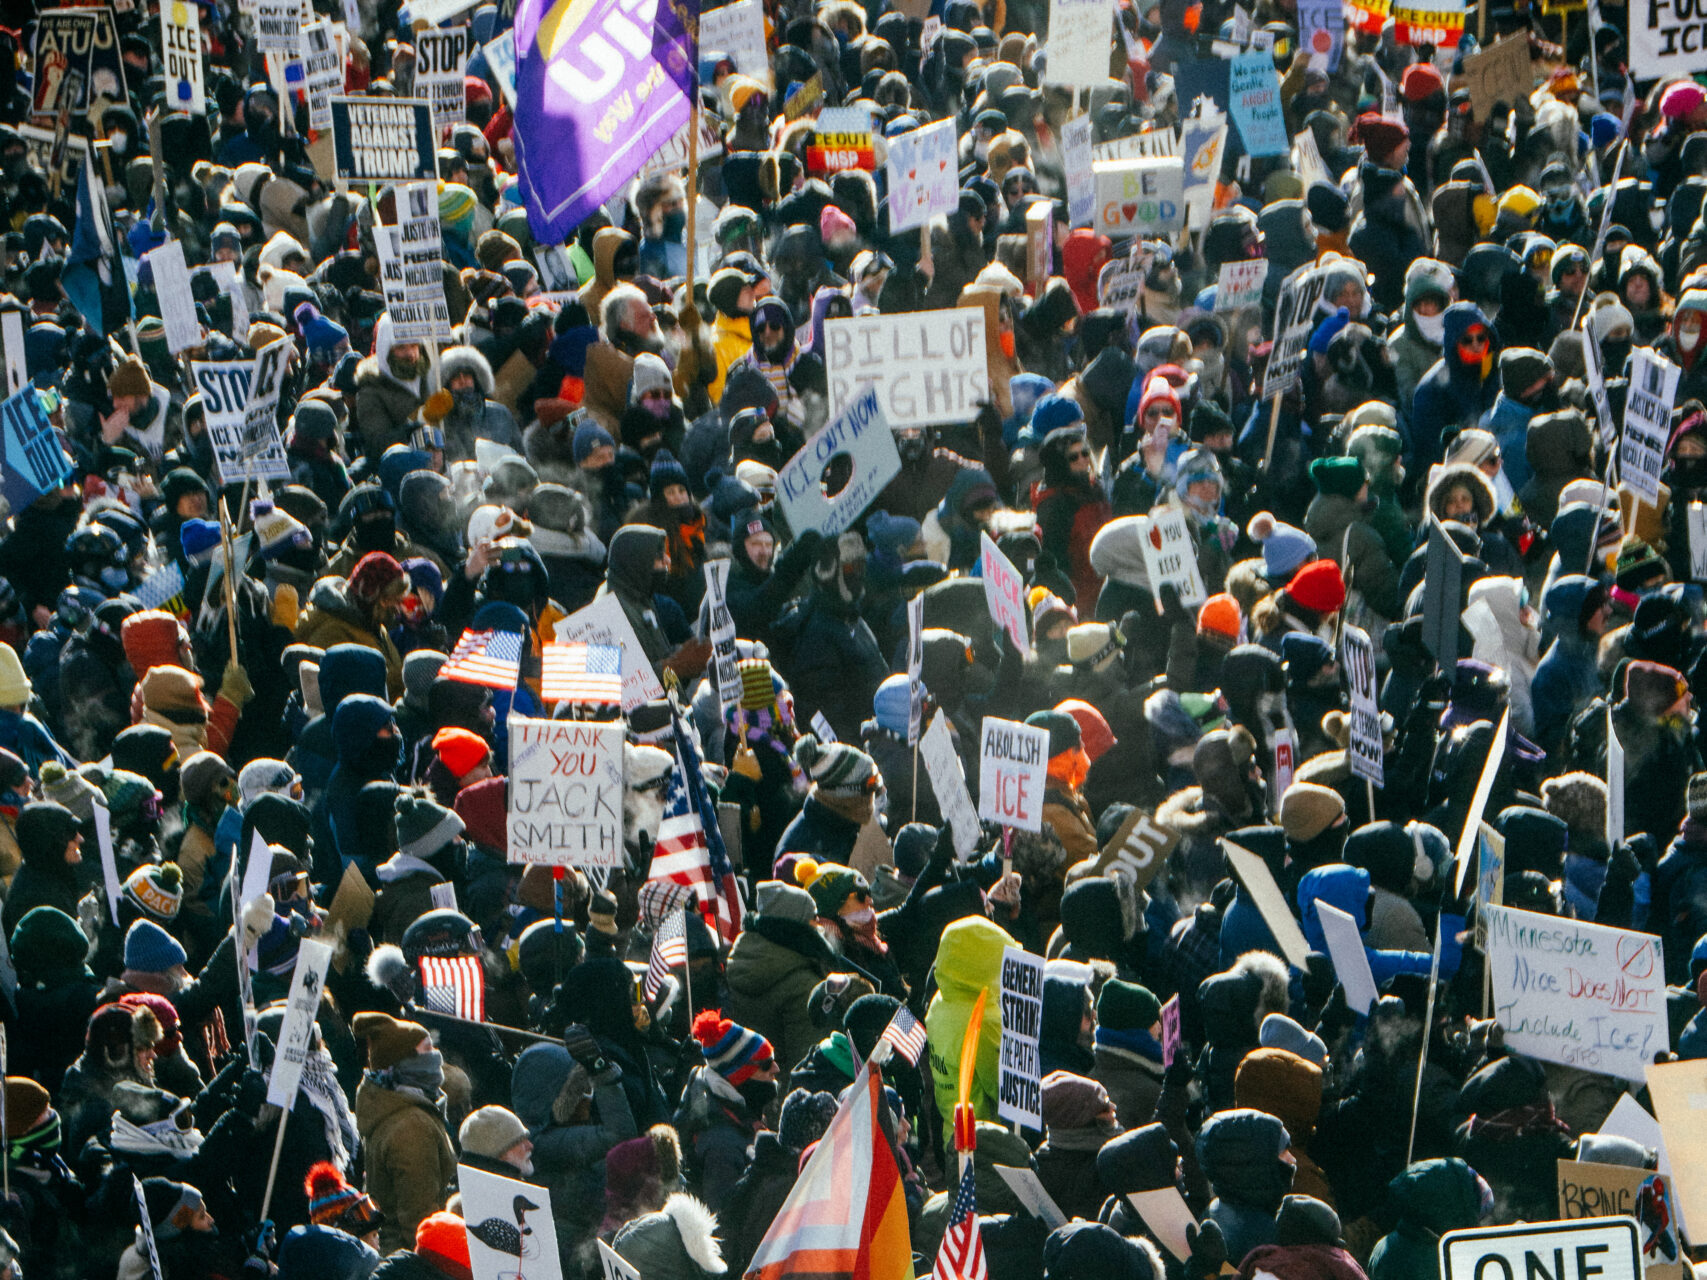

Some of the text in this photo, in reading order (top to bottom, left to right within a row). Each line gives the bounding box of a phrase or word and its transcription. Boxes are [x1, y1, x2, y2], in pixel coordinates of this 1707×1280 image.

[1424, 12, 1463, 26] OUT
[39, 29, 96, 55] ATU
[167, 23, 198, 54] ICE
[418, 34, 466, 74] STOP
[169, 53, 197, 83] OUT
[348, 103, 417, 125] VETERANS
[350, 125, 418, 149] AGAINST
[836, 132, 868, 147] OUT
[352, 149, 421, 180] TRUMP
[824, 149, 859, 169] MSP
[1123, 172, 1158, 204] BE
[830, 315, 983, 371] BILL OF
[2, 386, 54, 448] ICE
[26, 425, 73, 486] OUT
[781, 456, 815, 504] ICE
[815, 417, 848, 462] OUT
[849, 390, 881, 442] NOW
[1163, 521, 1183, 544] YOU
[985, 549, 1021, 613] FUCK
[1158, 554, 1182, 577] KEEP
[519, 724, 607, 752] THANK
[984, 728, 1042, 767] ABOLISH
[550, 751, 598, 778] YOU
[514, 779, 616, 821] JACK
[995, 767, 1032, 821] ICE
[512, 822, 617, 853] SMITH
[1104, 814, 1169, 892] OUT
[1486, 914, 1600, 958] Minnesota
[1511, 955, 1656, 1010] Nice Does NOT
[1498, 1002, 1583, 1044] Include
[1002, 1033, 1015, 1064] THE
[1014, 1039, 1034, 1071] PATH
[1561, 1043, 1601, 1066] GTFO
[1000, 1071, 1042, 1118] JUSTICE
[1561, 1178, 1636, 1222] BRING
